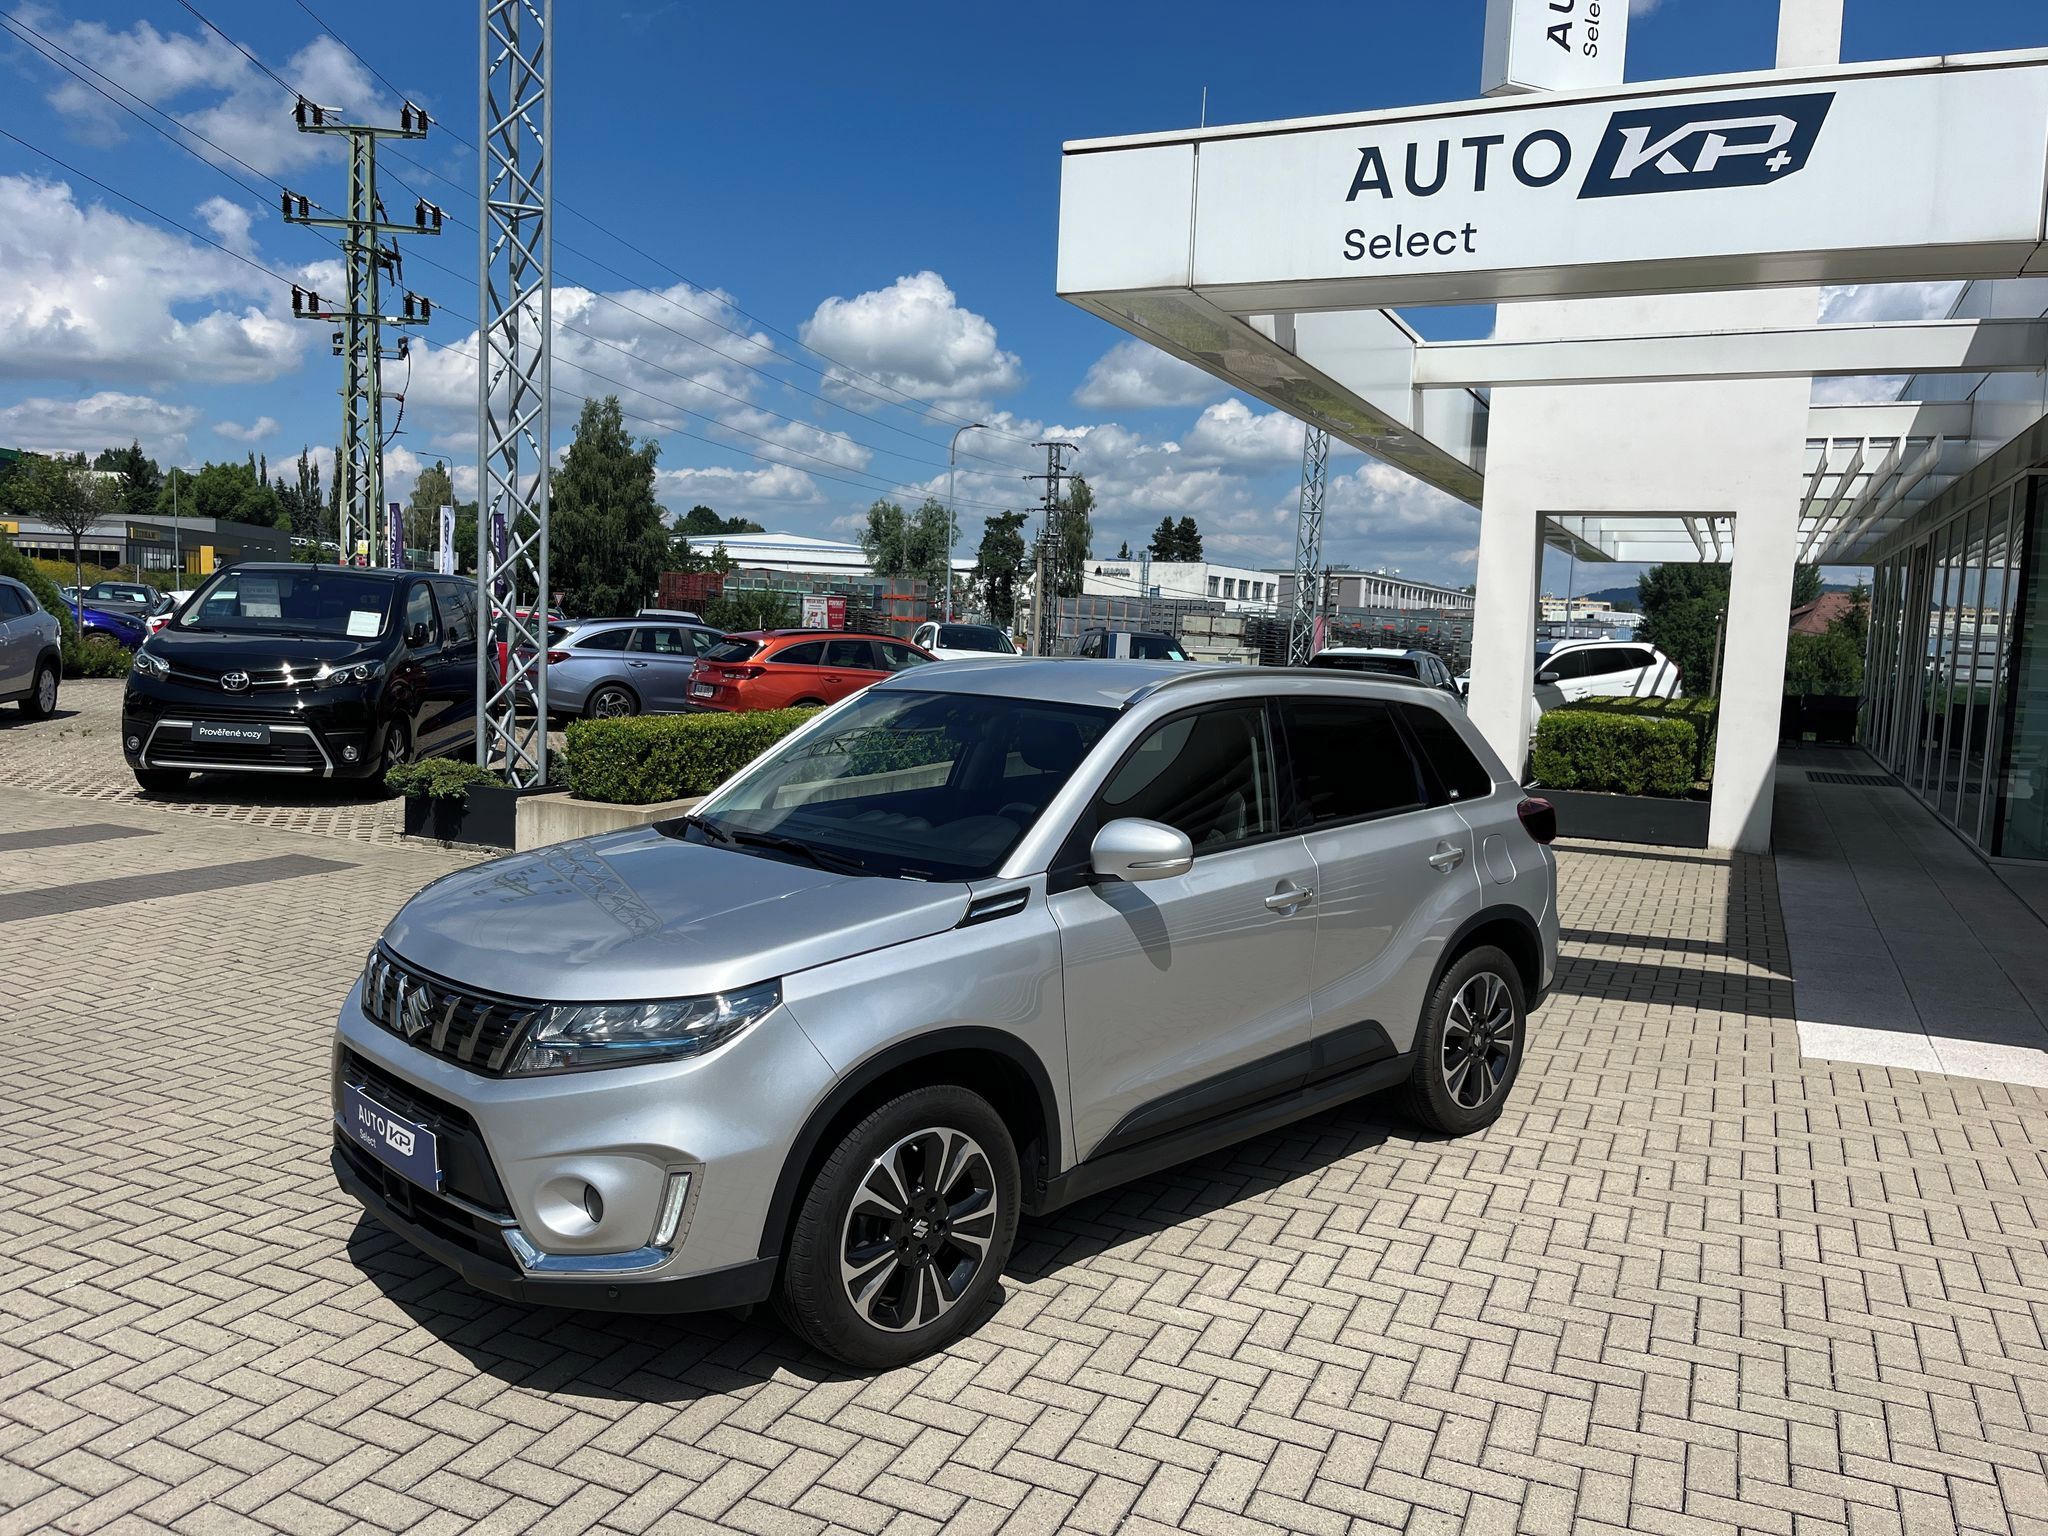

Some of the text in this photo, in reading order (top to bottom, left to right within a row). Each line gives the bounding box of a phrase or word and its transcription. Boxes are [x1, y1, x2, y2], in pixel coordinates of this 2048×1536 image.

[1583, 0, 1601, 58] Sele
[1346, 128, 1572, 202] AUTO
[1343, 222, 1478, 261] Select
[199, 727, 262, 740] Prověřené vozy
[358, 1103, 386, 1136] AUTO
[359, 1128, 377, 1149] Select
